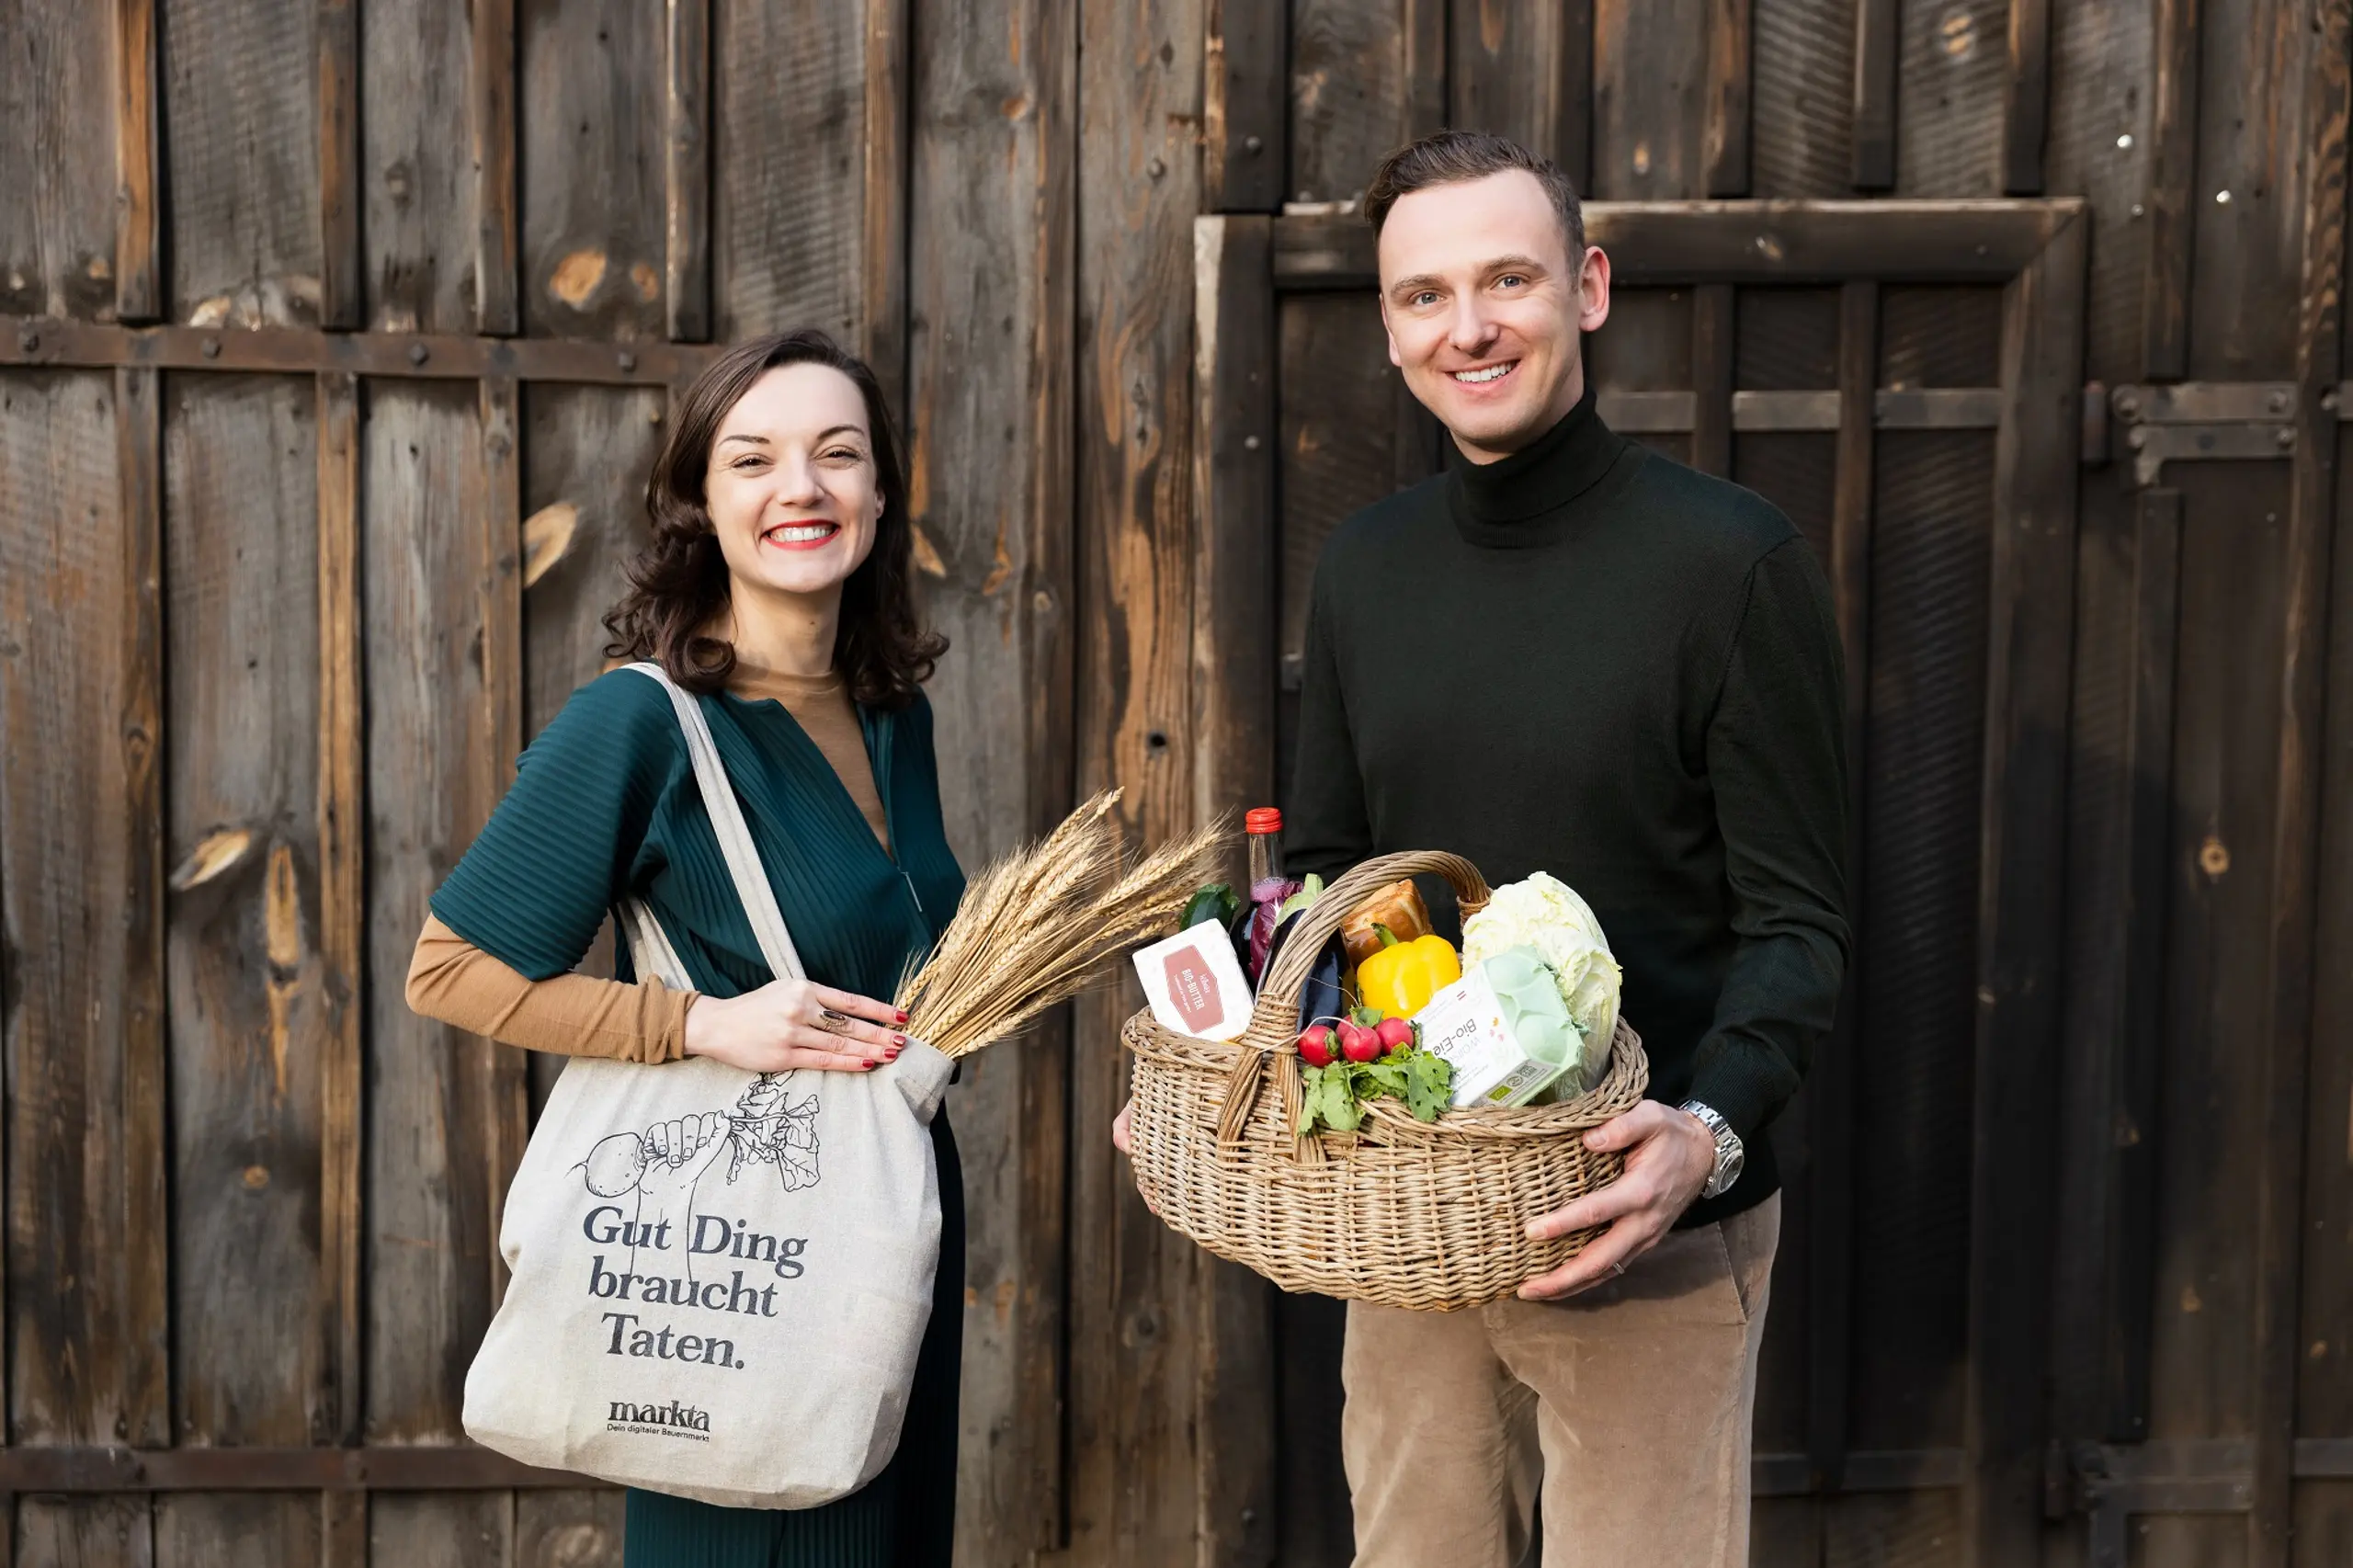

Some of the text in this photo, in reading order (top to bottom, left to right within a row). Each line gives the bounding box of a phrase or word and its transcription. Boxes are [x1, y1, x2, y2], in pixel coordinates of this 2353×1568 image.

[1433, 1018, 1477, 1055] Bio-Eie
[583, 1206, 809, 1279] Gut Ding
[588, 1255, 779, 1318] braucht
[601, 1312, 745, 1369] Taten.
[607, 1424, 710, 1443] Dein digitaler Bauernmarkt
[608, 1400, 710, 1433] markta
